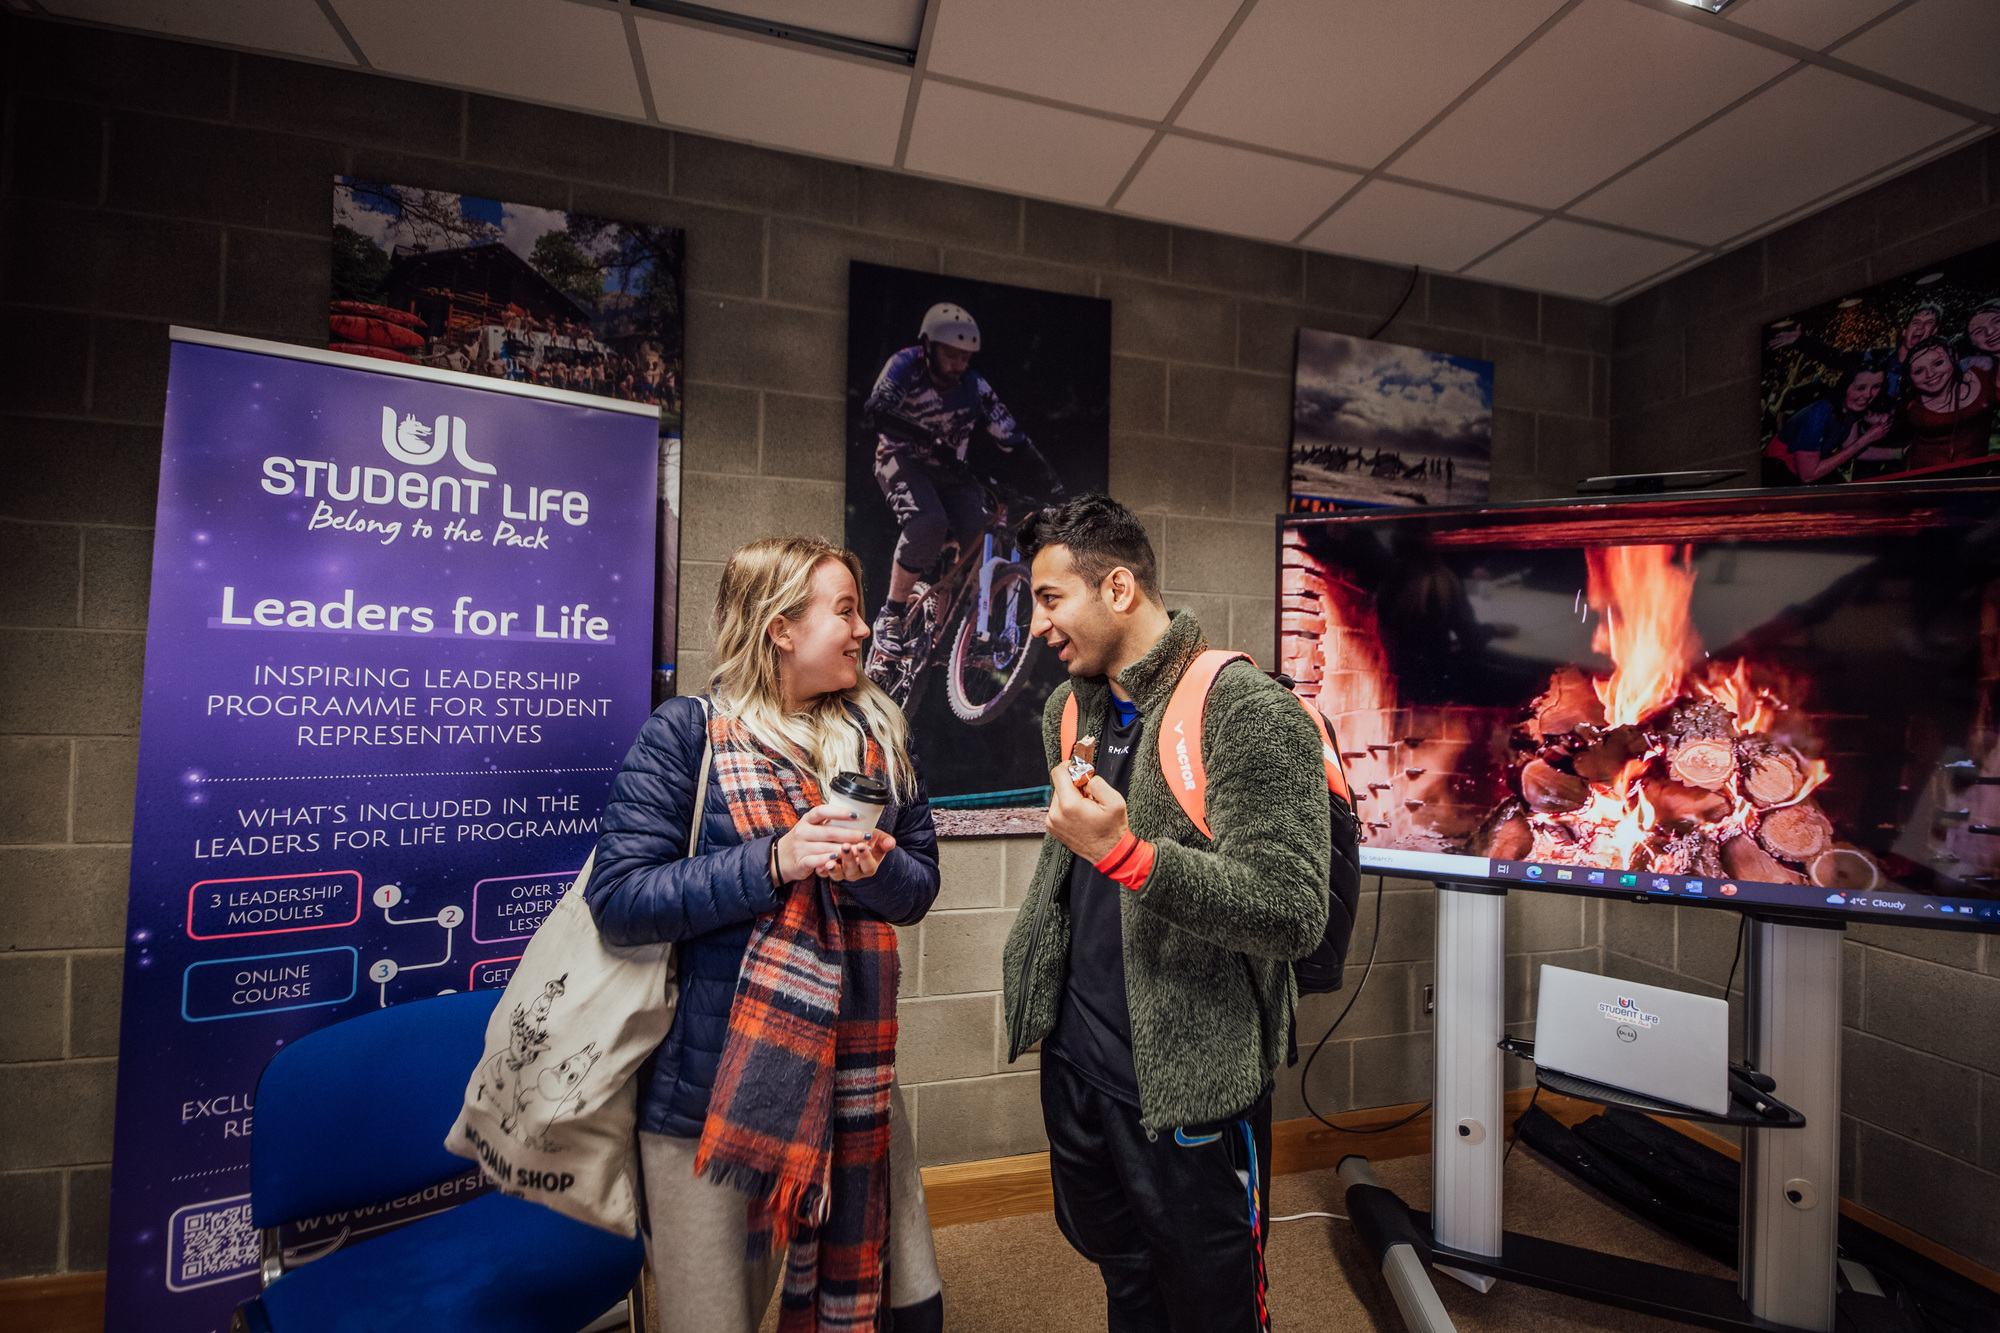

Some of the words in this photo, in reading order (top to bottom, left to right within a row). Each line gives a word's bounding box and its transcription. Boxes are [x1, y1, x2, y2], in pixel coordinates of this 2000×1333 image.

[382, 406, 497, 475] UL
[308, 500, 403, 545] Belong
[411, 518, 433, 539] to
[443, 518, 484, 543] the
[492, 521, 550, 550] Pack
[221, 586, 434, 634] Leaders
[452, 597, 518, 637] for
[535, 604, 609, 641] Life
[255, 665, 410, 688] INSPIRING
[424, 669, 581, 692] LEADERSHIP
[207, 695, 417, 716] PROGRAMME
[430, 697, 487, 717] FOR
[496, 698, 612, 717] STUDENT
[297, 724, 542, 746] REPRESENTATIVES
[1176, 737, 1196, 791] VICTOR
[238, 804, 346, 828] WHAT'S
[360, 799, 491, 822] INCLUDED
[503, 797, 527, 815] IN
[537, 794, 580, 812] THE
[195, 833, 320, 858] LEADERS
[333, 830, 390, 850] FOR
[400, 826, 446, 846] LIFE
[457, 817, 602, 842] PROGRAMM
[210, 894, 222, 908] 3
[229, 885, 343, 907] LEADERSHIP
[384, 890, 391, 903] 1
[511, 884, 553, 899] OVER
[228, 904, 324, 926] MODULES
[1849, 897, 1868, 906] 4°C
[1872, 899, 1907, 911] Cloudy
[446, 910, 456, 923] 2
[235, 964, 311, 986] ONLINE
[378, 964, 389, 978] 3
[482, 968, 512, 983] GET
[232, 982, 311, 1006] COURSE
[182, 1093, 255, 1121] EXCLU
[517, 1168, 575, 1193] SHOP
